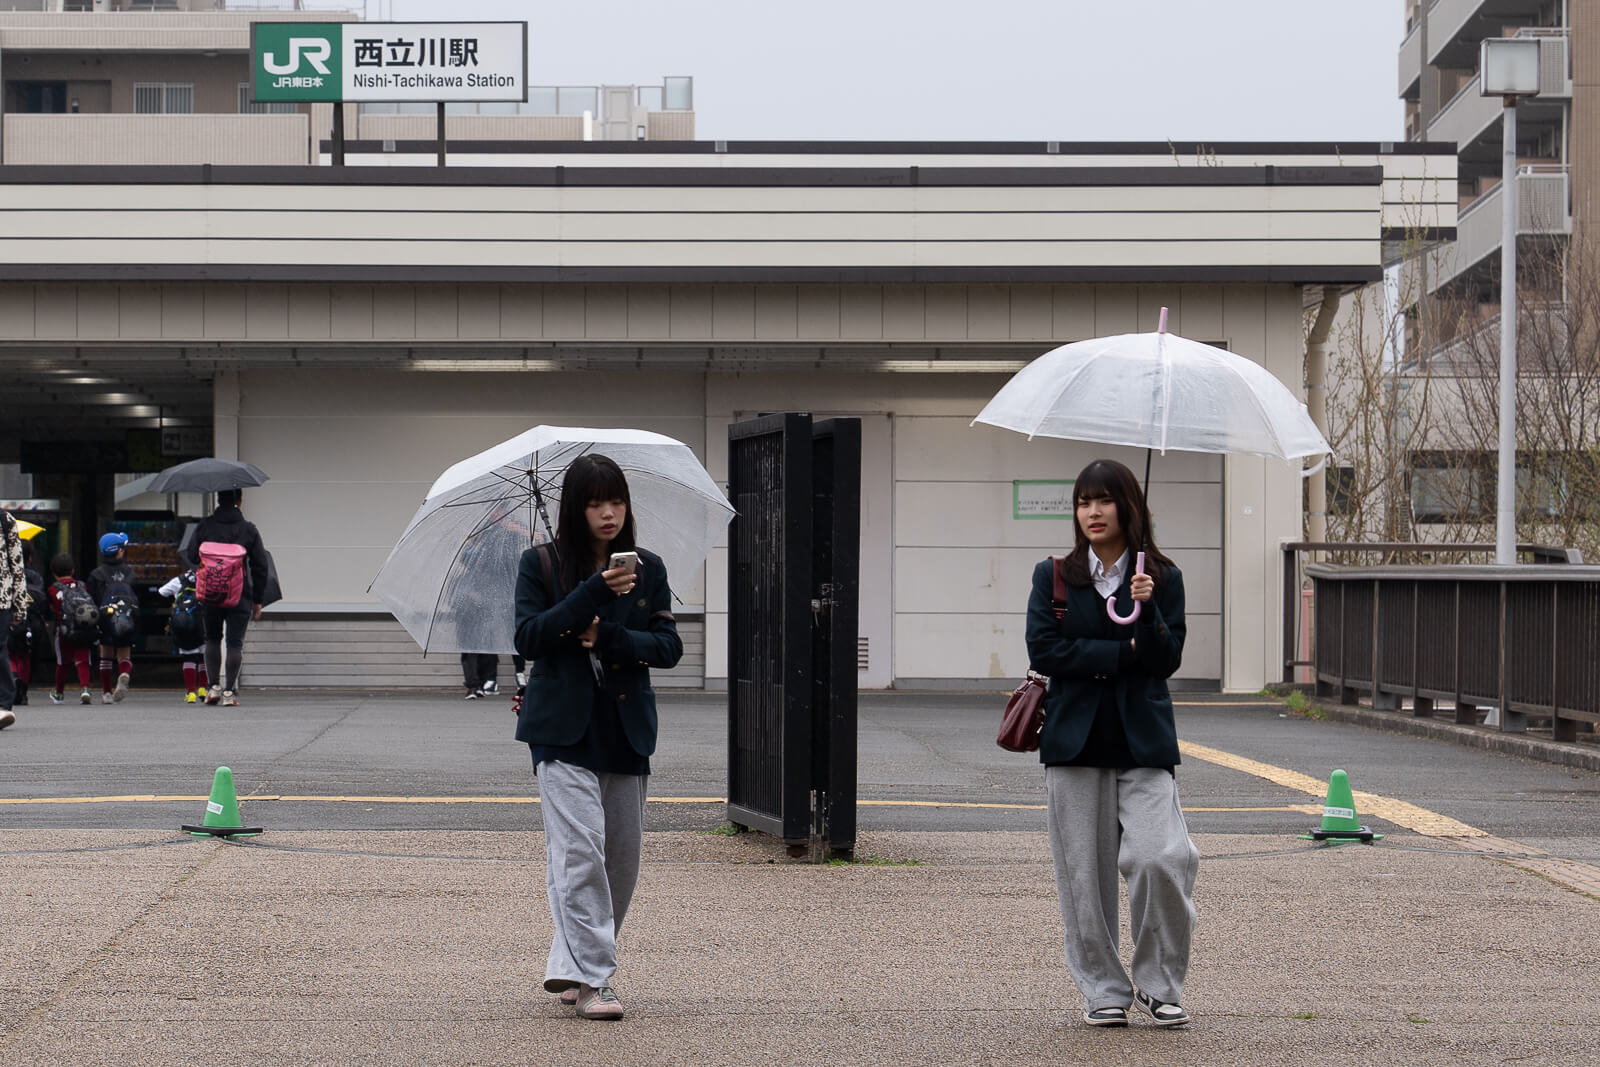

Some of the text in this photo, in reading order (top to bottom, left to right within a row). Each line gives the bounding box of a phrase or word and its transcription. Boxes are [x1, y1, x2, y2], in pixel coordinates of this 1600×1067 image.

[263, 37, 332, 75] JR
[354, 38, 478, 67] 西立川駅
[272, 76, 324, 88] JR東日本
[353, 73, 514, 88] Nishi-Tachikawa Station
